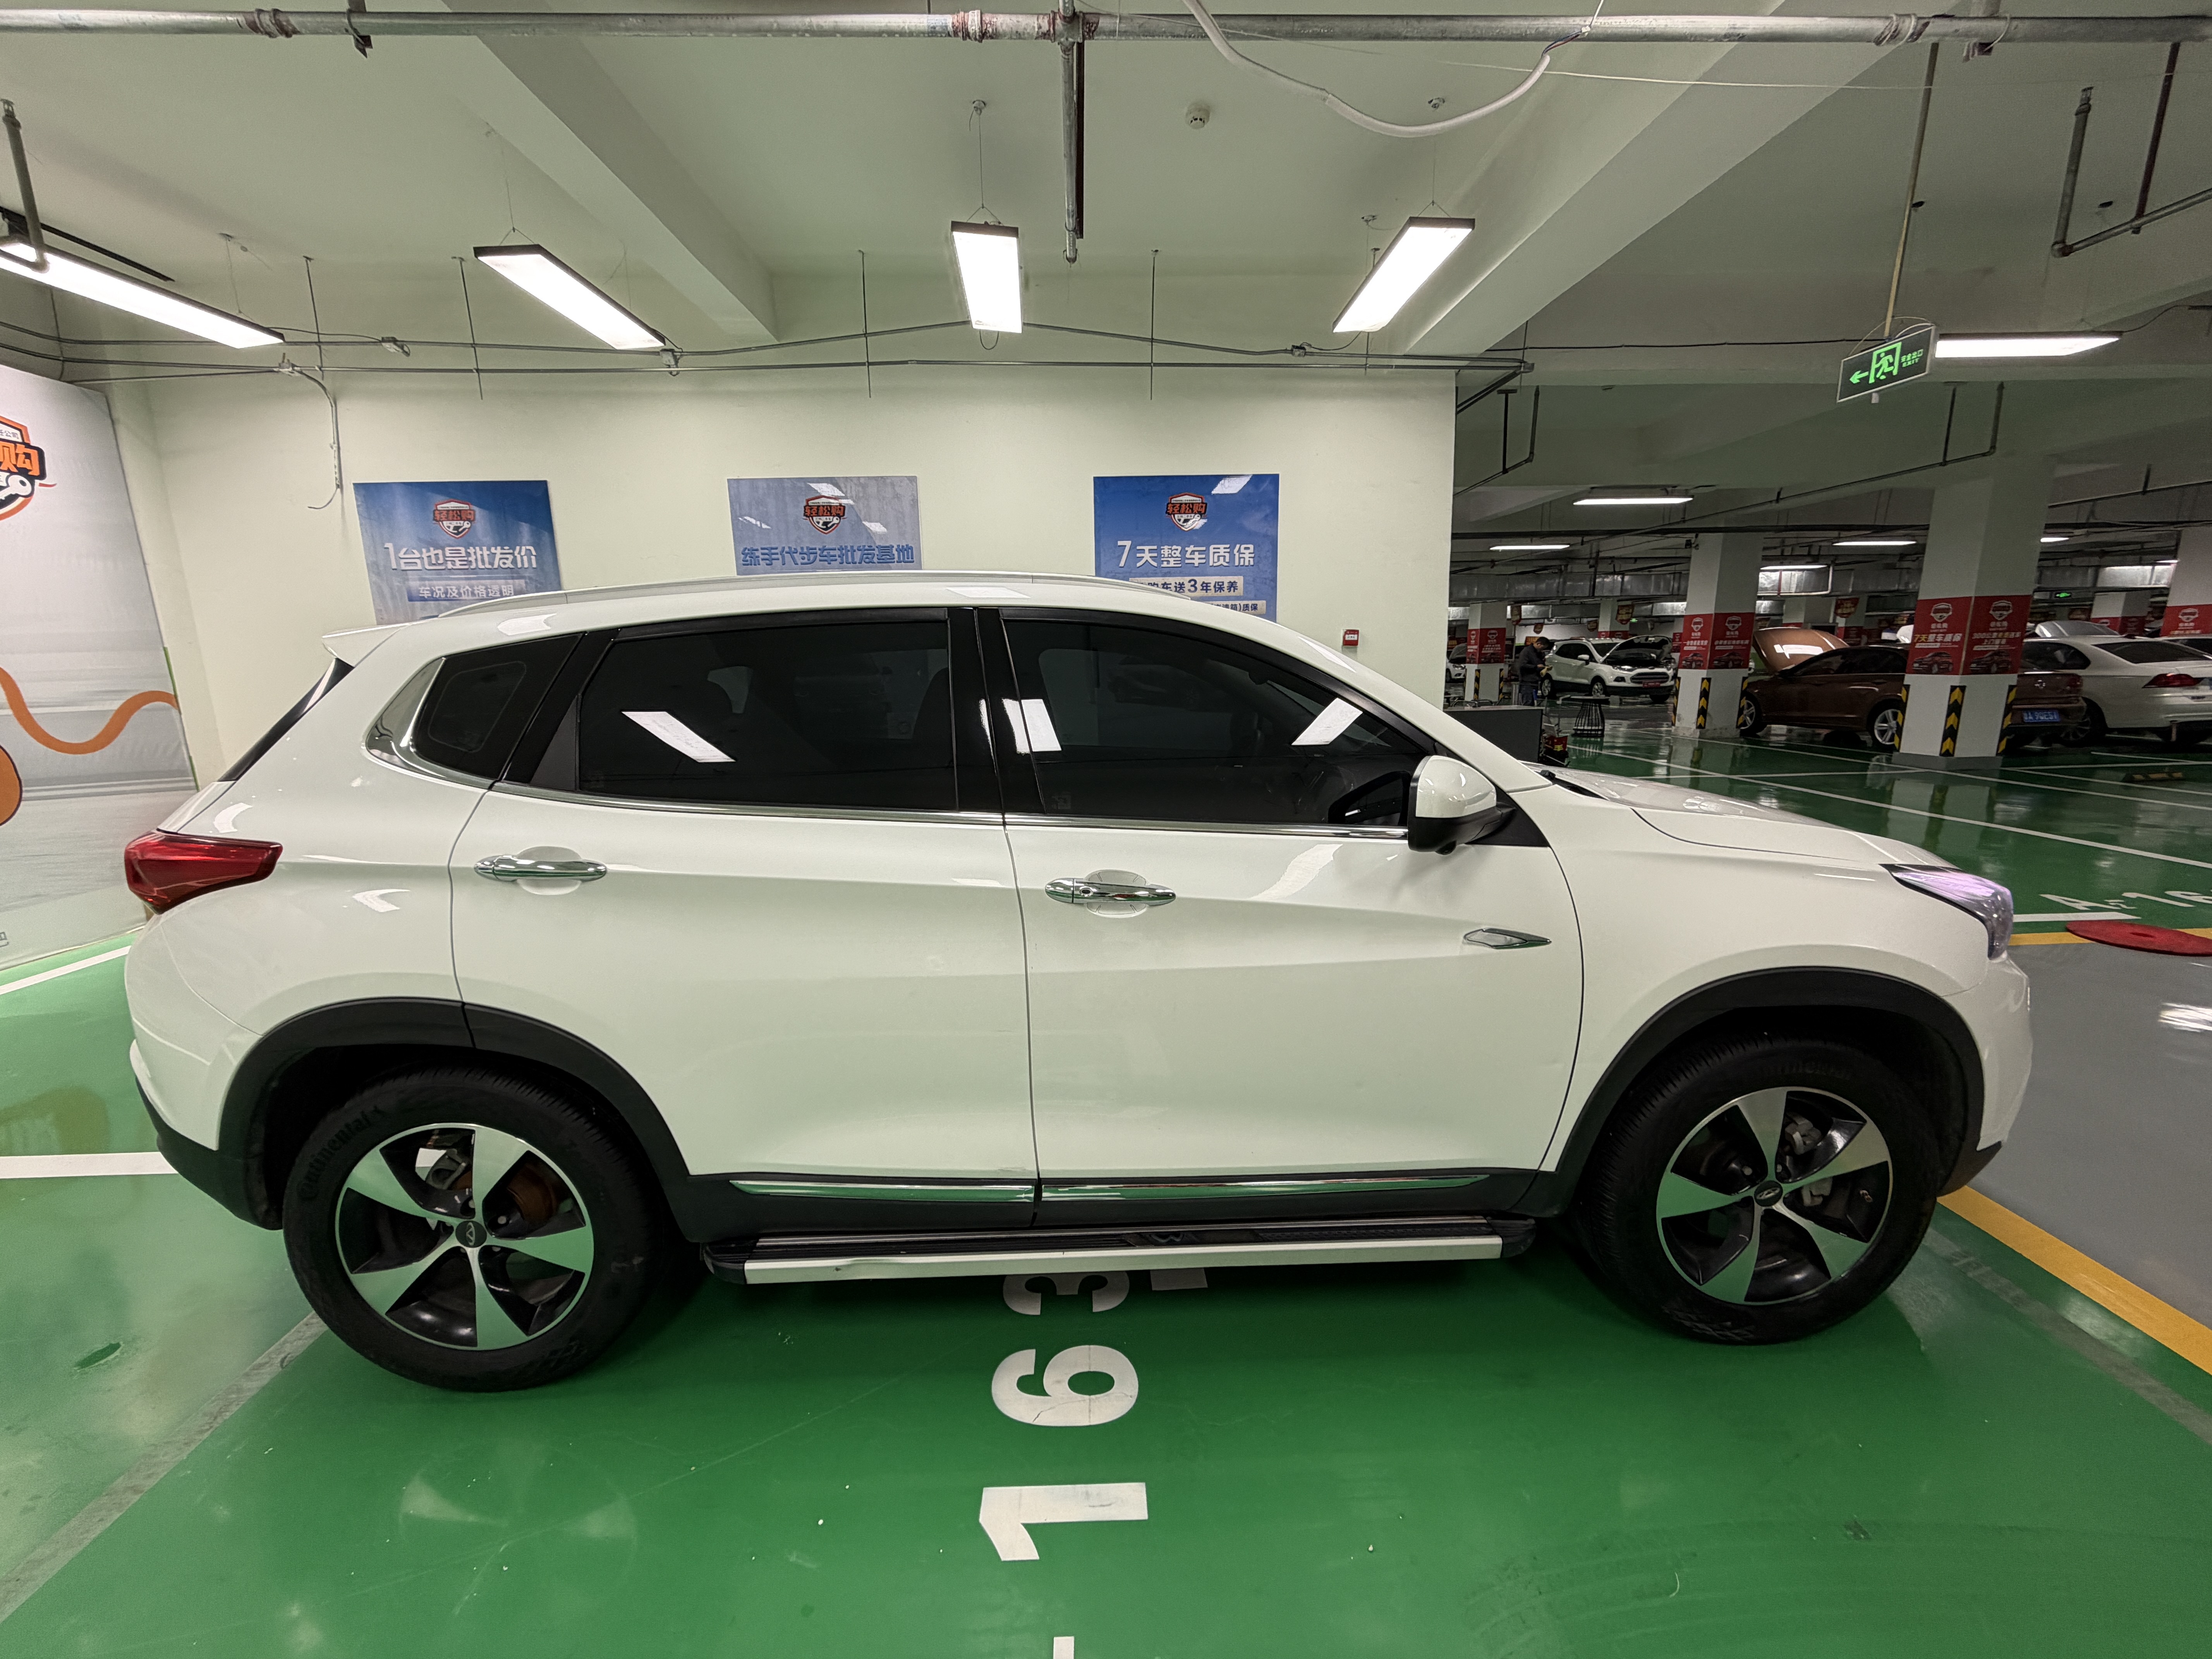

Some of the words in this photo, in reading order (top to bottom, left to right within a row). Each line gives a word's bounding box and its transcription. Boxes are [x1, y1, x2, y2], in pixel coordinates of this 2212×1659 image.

[805, 506, 844, 516] 轻松购
[1167, 503, 1206, 514] 轻松购
[434, 510, 474, 521] 轻松购
[384, 543, 537, 570] 1台也是批发价
[741, 544, 915, 566] 练手代步车批发基地
[1117, 541, 1255, 568] 7天整车质保
[419, 585, 514, 598] 车况及价格透明
[1135, 579, 1238, 593] 车送3年保养
